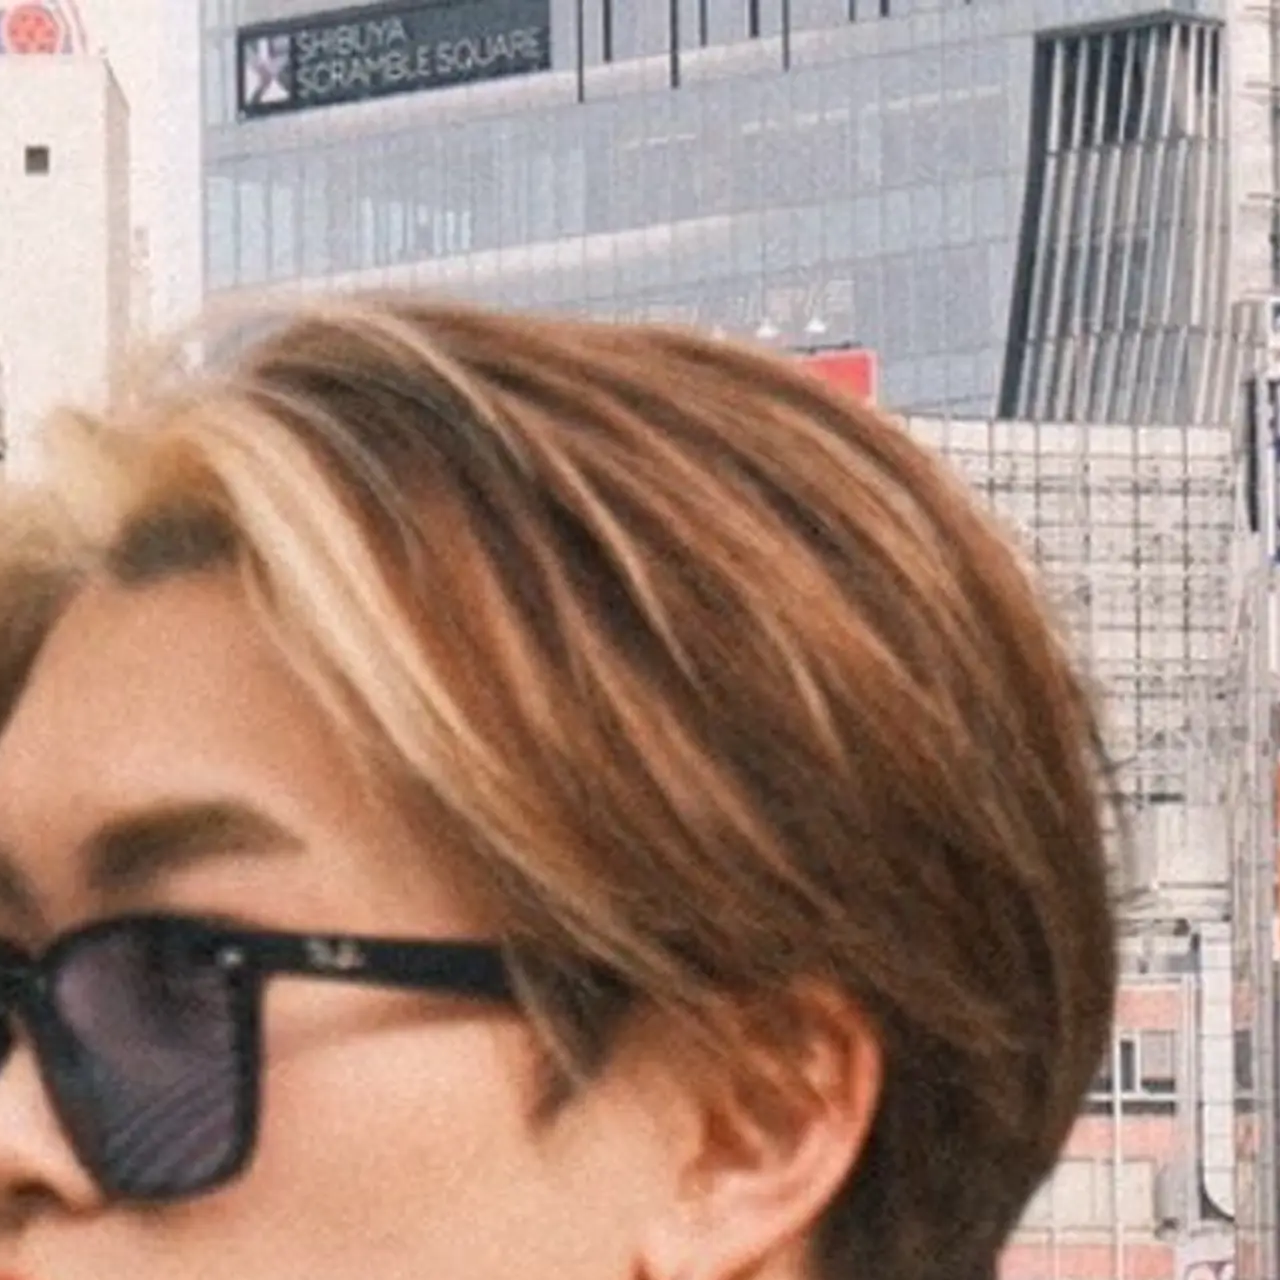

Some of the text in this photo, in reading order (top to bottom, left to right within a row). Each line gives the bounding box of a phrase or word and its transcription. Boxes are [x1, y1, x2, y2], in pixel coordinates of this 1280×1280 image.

[294, 16, 405, 58] SHIBUYA
[297, 27, 541, 98] SCRAMBLE SQUARE
